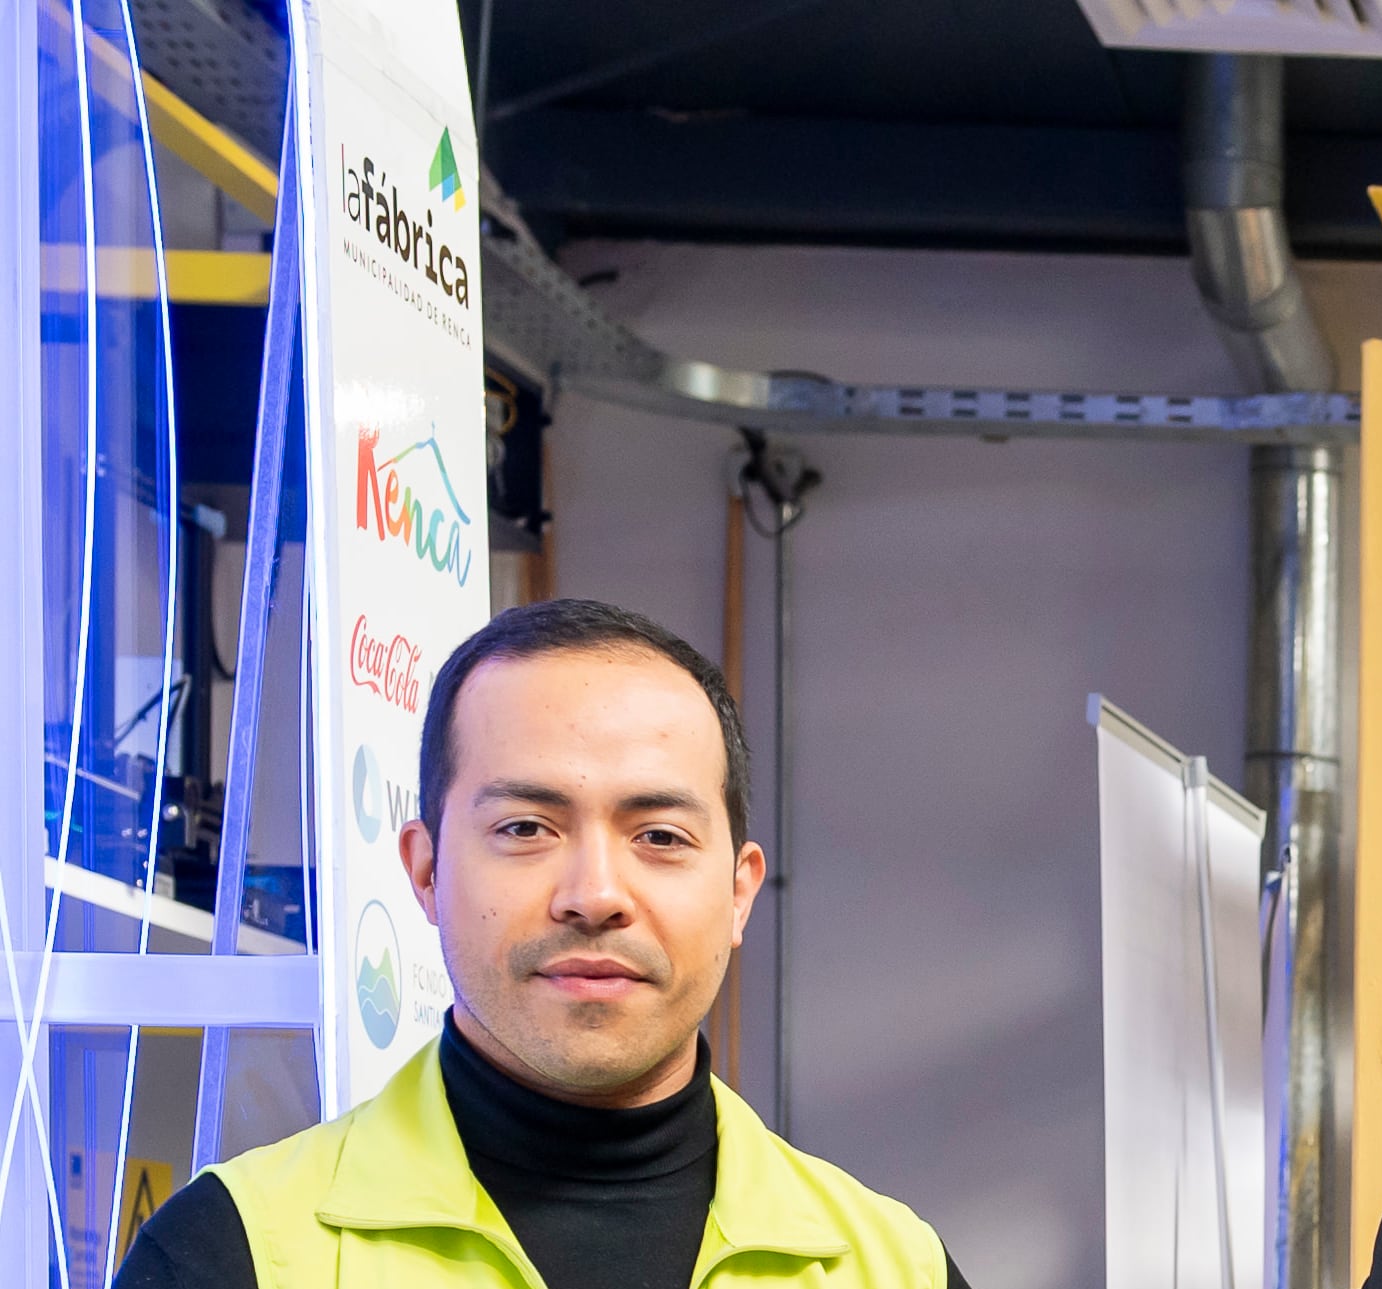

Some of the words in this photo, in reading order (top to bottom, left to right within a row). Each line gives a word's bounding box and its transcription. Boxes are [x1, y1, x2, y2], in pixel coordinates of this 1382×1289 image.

[343, 237, 423, 312] MUNICIPALIDAD
[426, 301, 438, 325] DE
[441, 312, 471, 350] RENCA
